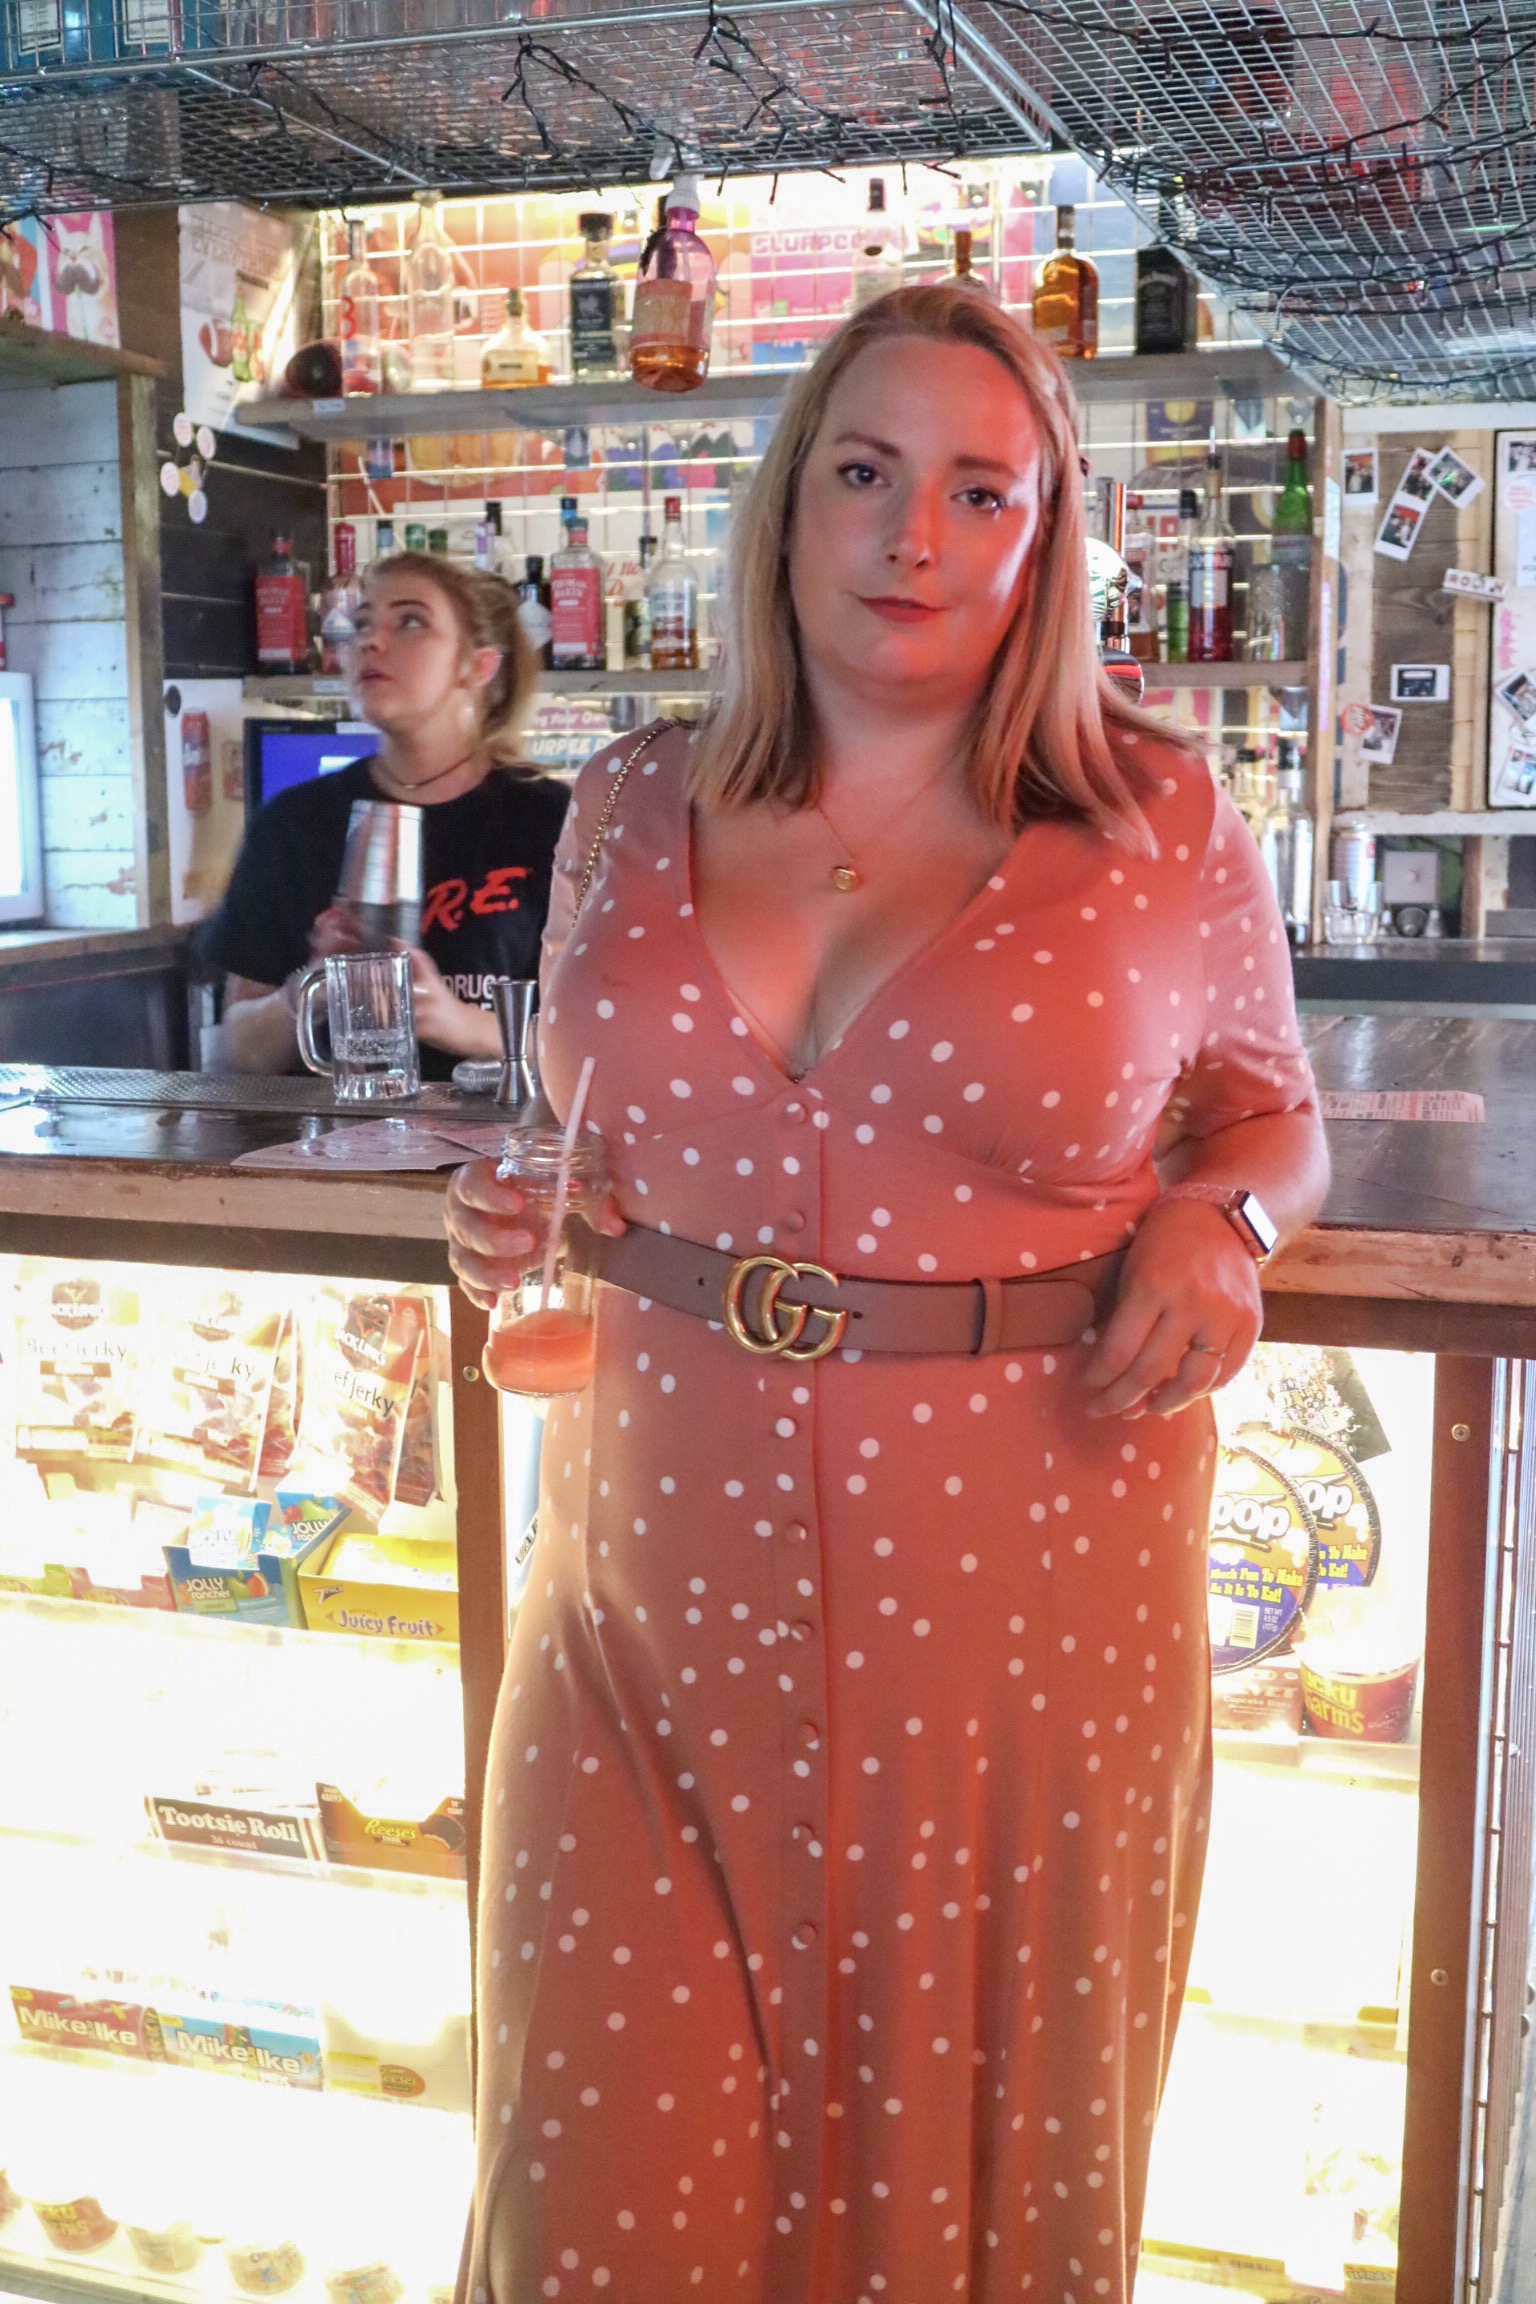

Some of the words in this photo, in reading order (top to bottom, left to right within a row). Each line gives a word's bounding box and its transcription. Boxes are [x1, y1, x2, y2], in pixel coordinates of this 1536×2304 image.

[348, 1377, 395, 1418] Jerky
[1341, 1543, 1368, 1561] Make
[186, 1577, 224, 1592] JOLLY
[1239, 1567, 1260, 1582] Fun
[1261, 1567, 1275, 1583] To
[1276, 1568, 1304, 1587] Make
[191, 1590, 230, 1600] rancher
[1223, 1582, 1233, 1595] It
[1246, 1584, 1260, 1599] To
[1261, 1585, 1283, 1604] Eat!
[338, 1609, 383, 1634] Juicy
[387, 1615, 434, 1636] Fruit
[158, 1805, 248, 1834] Tootsie
[246, 1816, 300, 1842] Roll
[211, 1835, 224, 1845] 36
[226, 1838, 258, 1850] count
[17, 2004, 88, 2035] Mike
[94, 2020, 138, 2046] Ike
[175, 2029, 249, 2062] Mike
[256, 2048, 301, 2074] Ike
